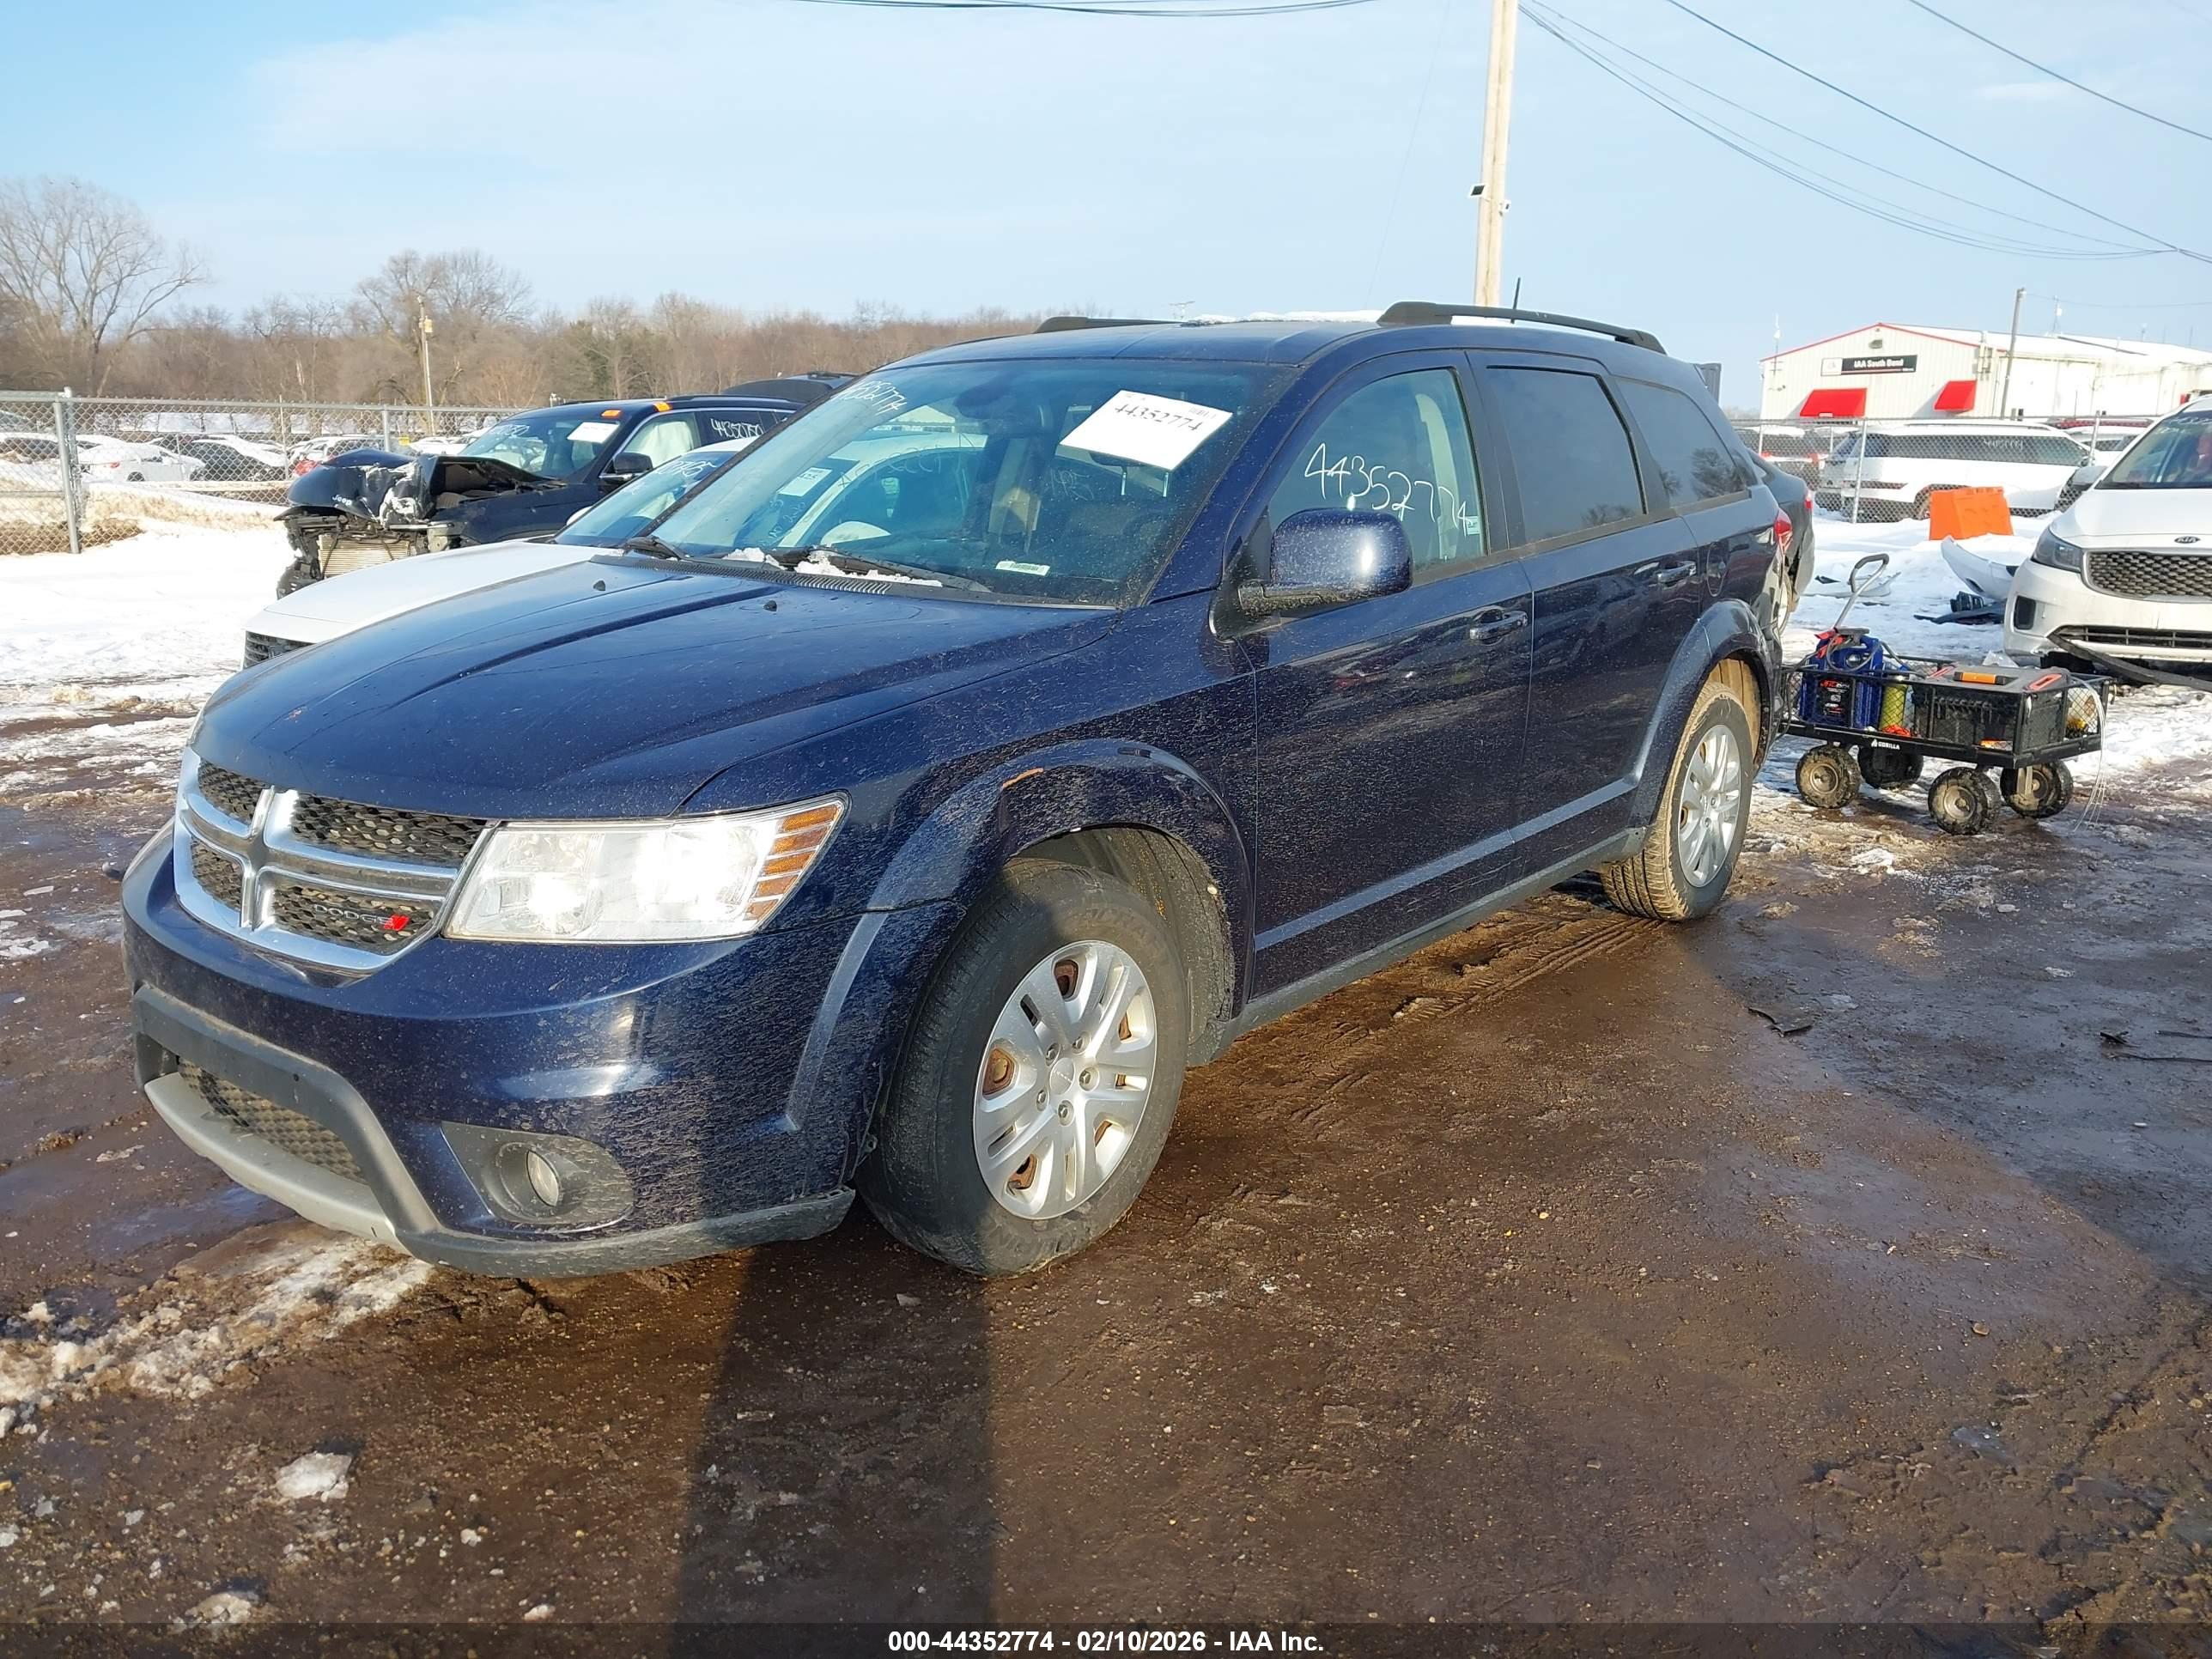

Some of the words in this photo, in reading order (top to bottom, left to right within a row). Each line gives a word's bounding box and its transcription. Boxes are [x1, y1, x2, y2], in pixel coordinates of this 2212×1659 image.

[1867, 359, 1886, 368] South
[1887, 358, 1904, 367] Bend
[1115, 403, 1203, 432] 44352774
[1304, 442, 1473, 538] 44352774
[331, 494, 353, 507] Jeep
[1878, 741, 1900, 750] GORILLA
[313, 903, 394, 926] DODGE
